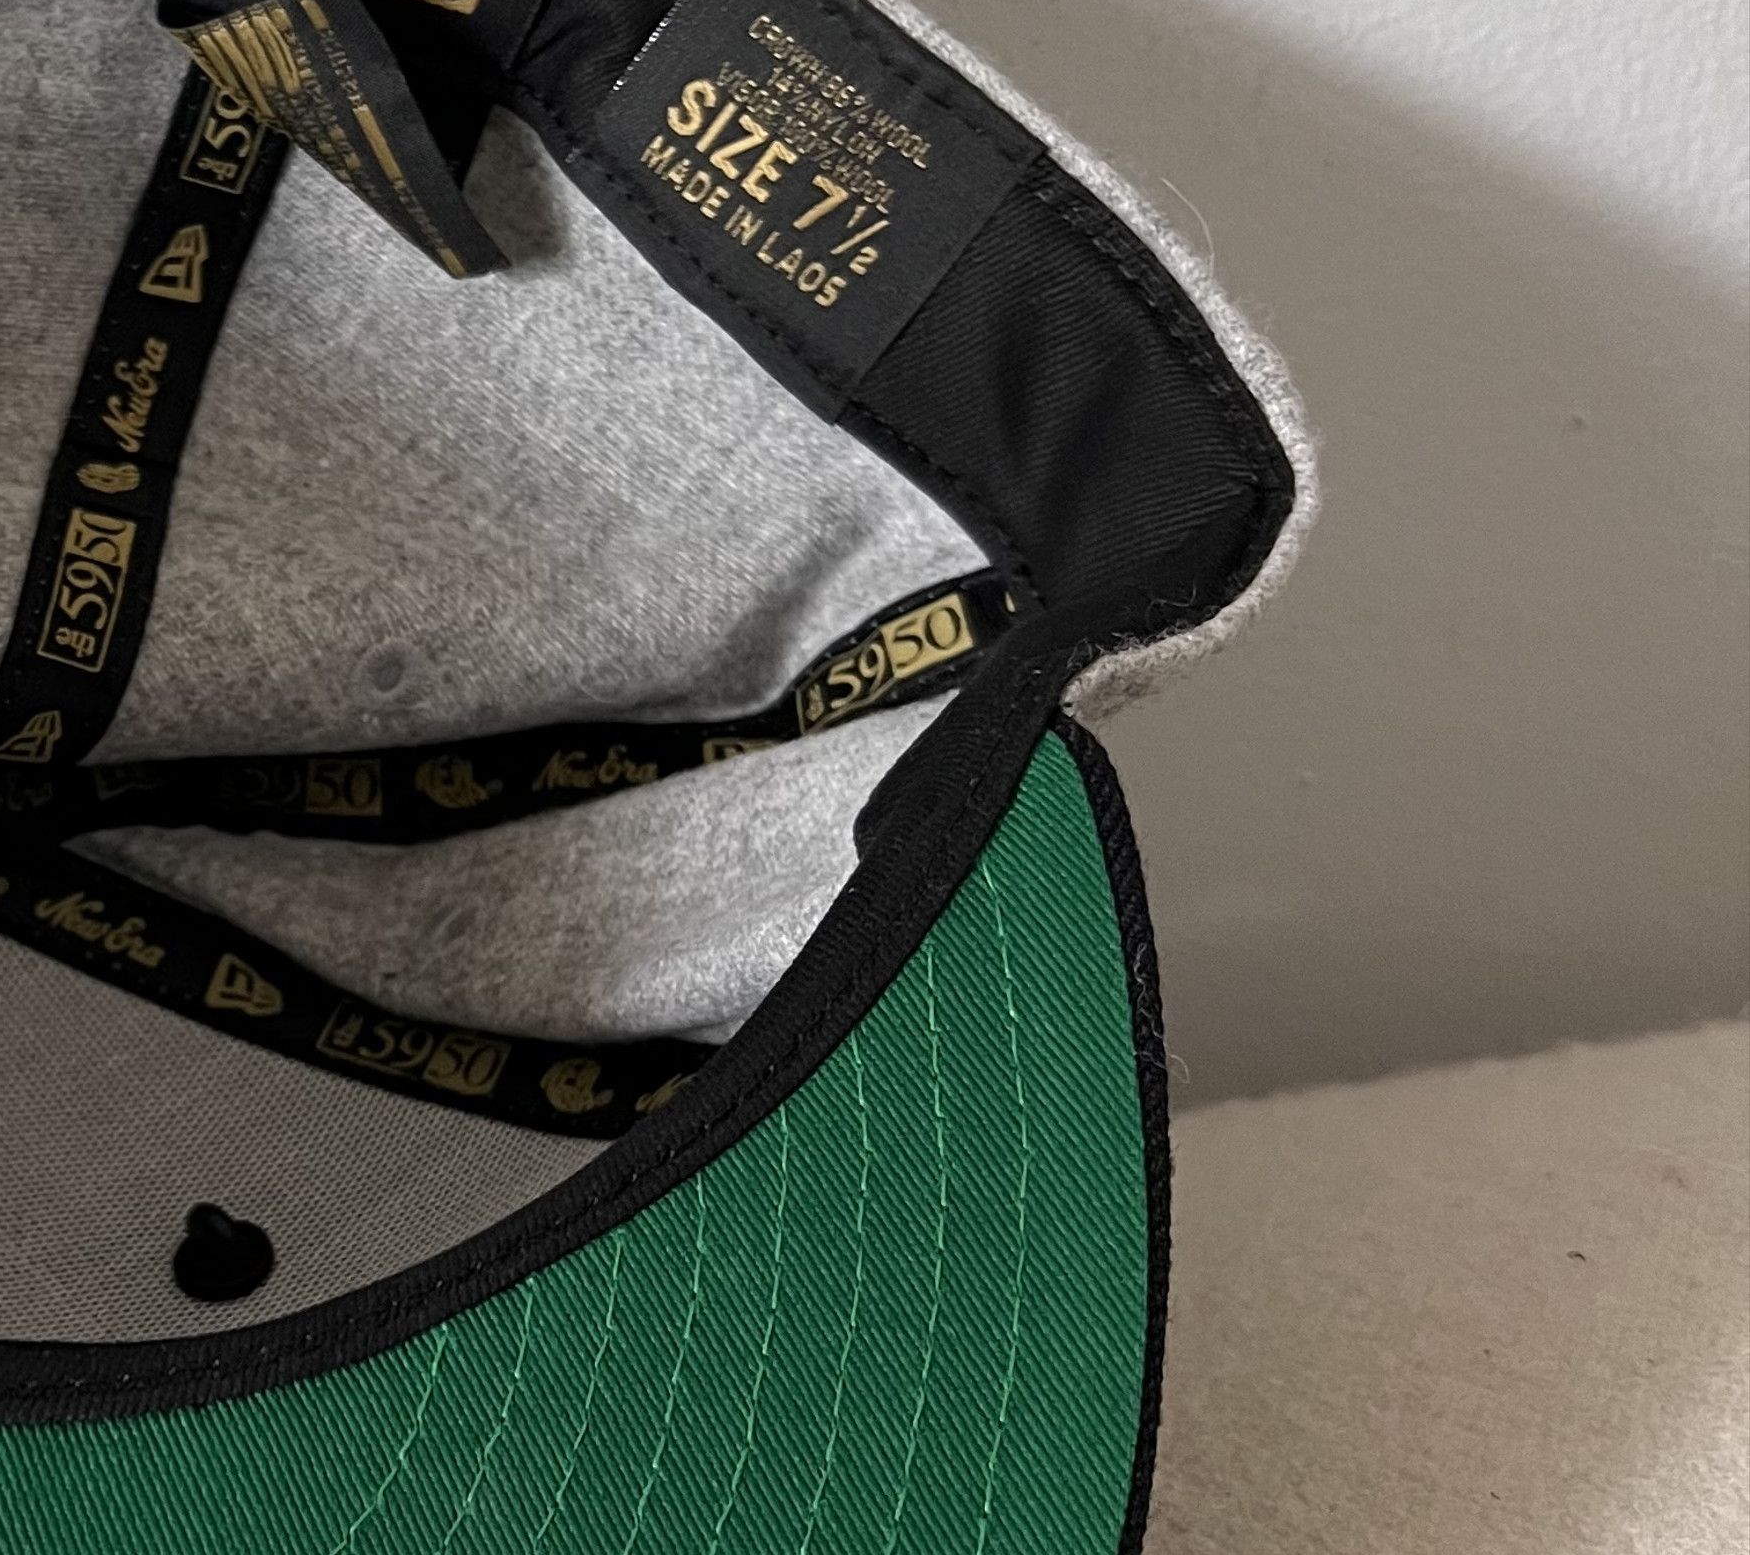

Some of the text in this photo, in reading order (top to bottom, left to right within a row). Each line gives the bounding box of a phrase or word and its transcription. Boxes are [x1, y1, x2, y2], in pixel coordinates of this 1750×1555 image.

[640, 135, 848, 308] MADE IN LAOS
[666, 77, 799, 204] SIZE
[792, 174, 850, 231] 7
[827, 606, 962, 710] 5950
